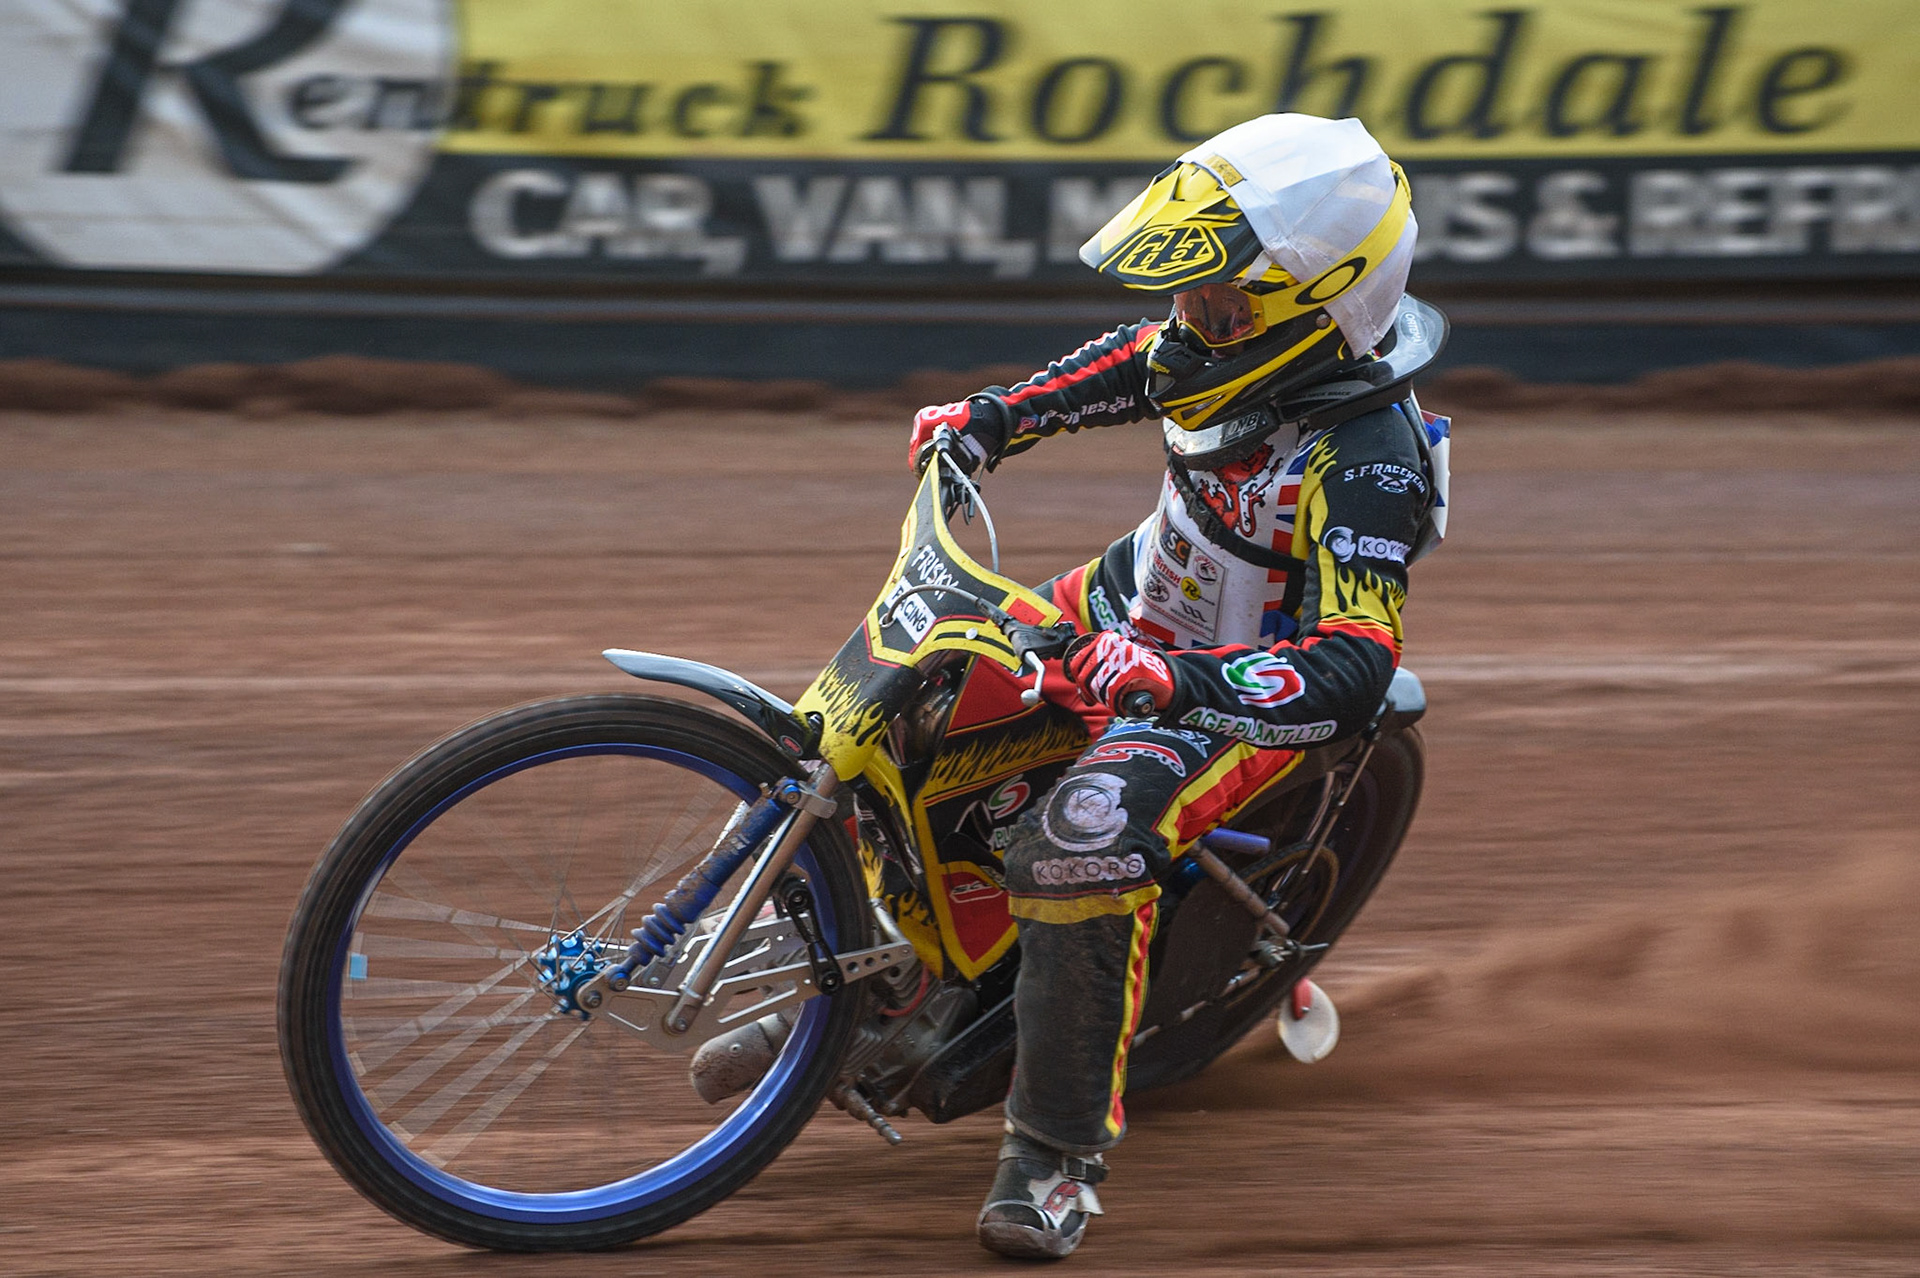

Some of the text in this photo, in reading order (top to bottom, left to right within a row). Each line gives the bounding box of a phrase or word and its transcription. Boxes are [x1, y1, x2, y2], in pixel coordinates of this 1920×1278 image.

[866, 6, 1850, 142] Rochdale
[911, 544, 959, 601] FRISKY
[1231, 720, 1294, 745] PLANT
[1294, 723, 1334, 742] LTD
[1036, 858, 1142, 880] KOKORO
